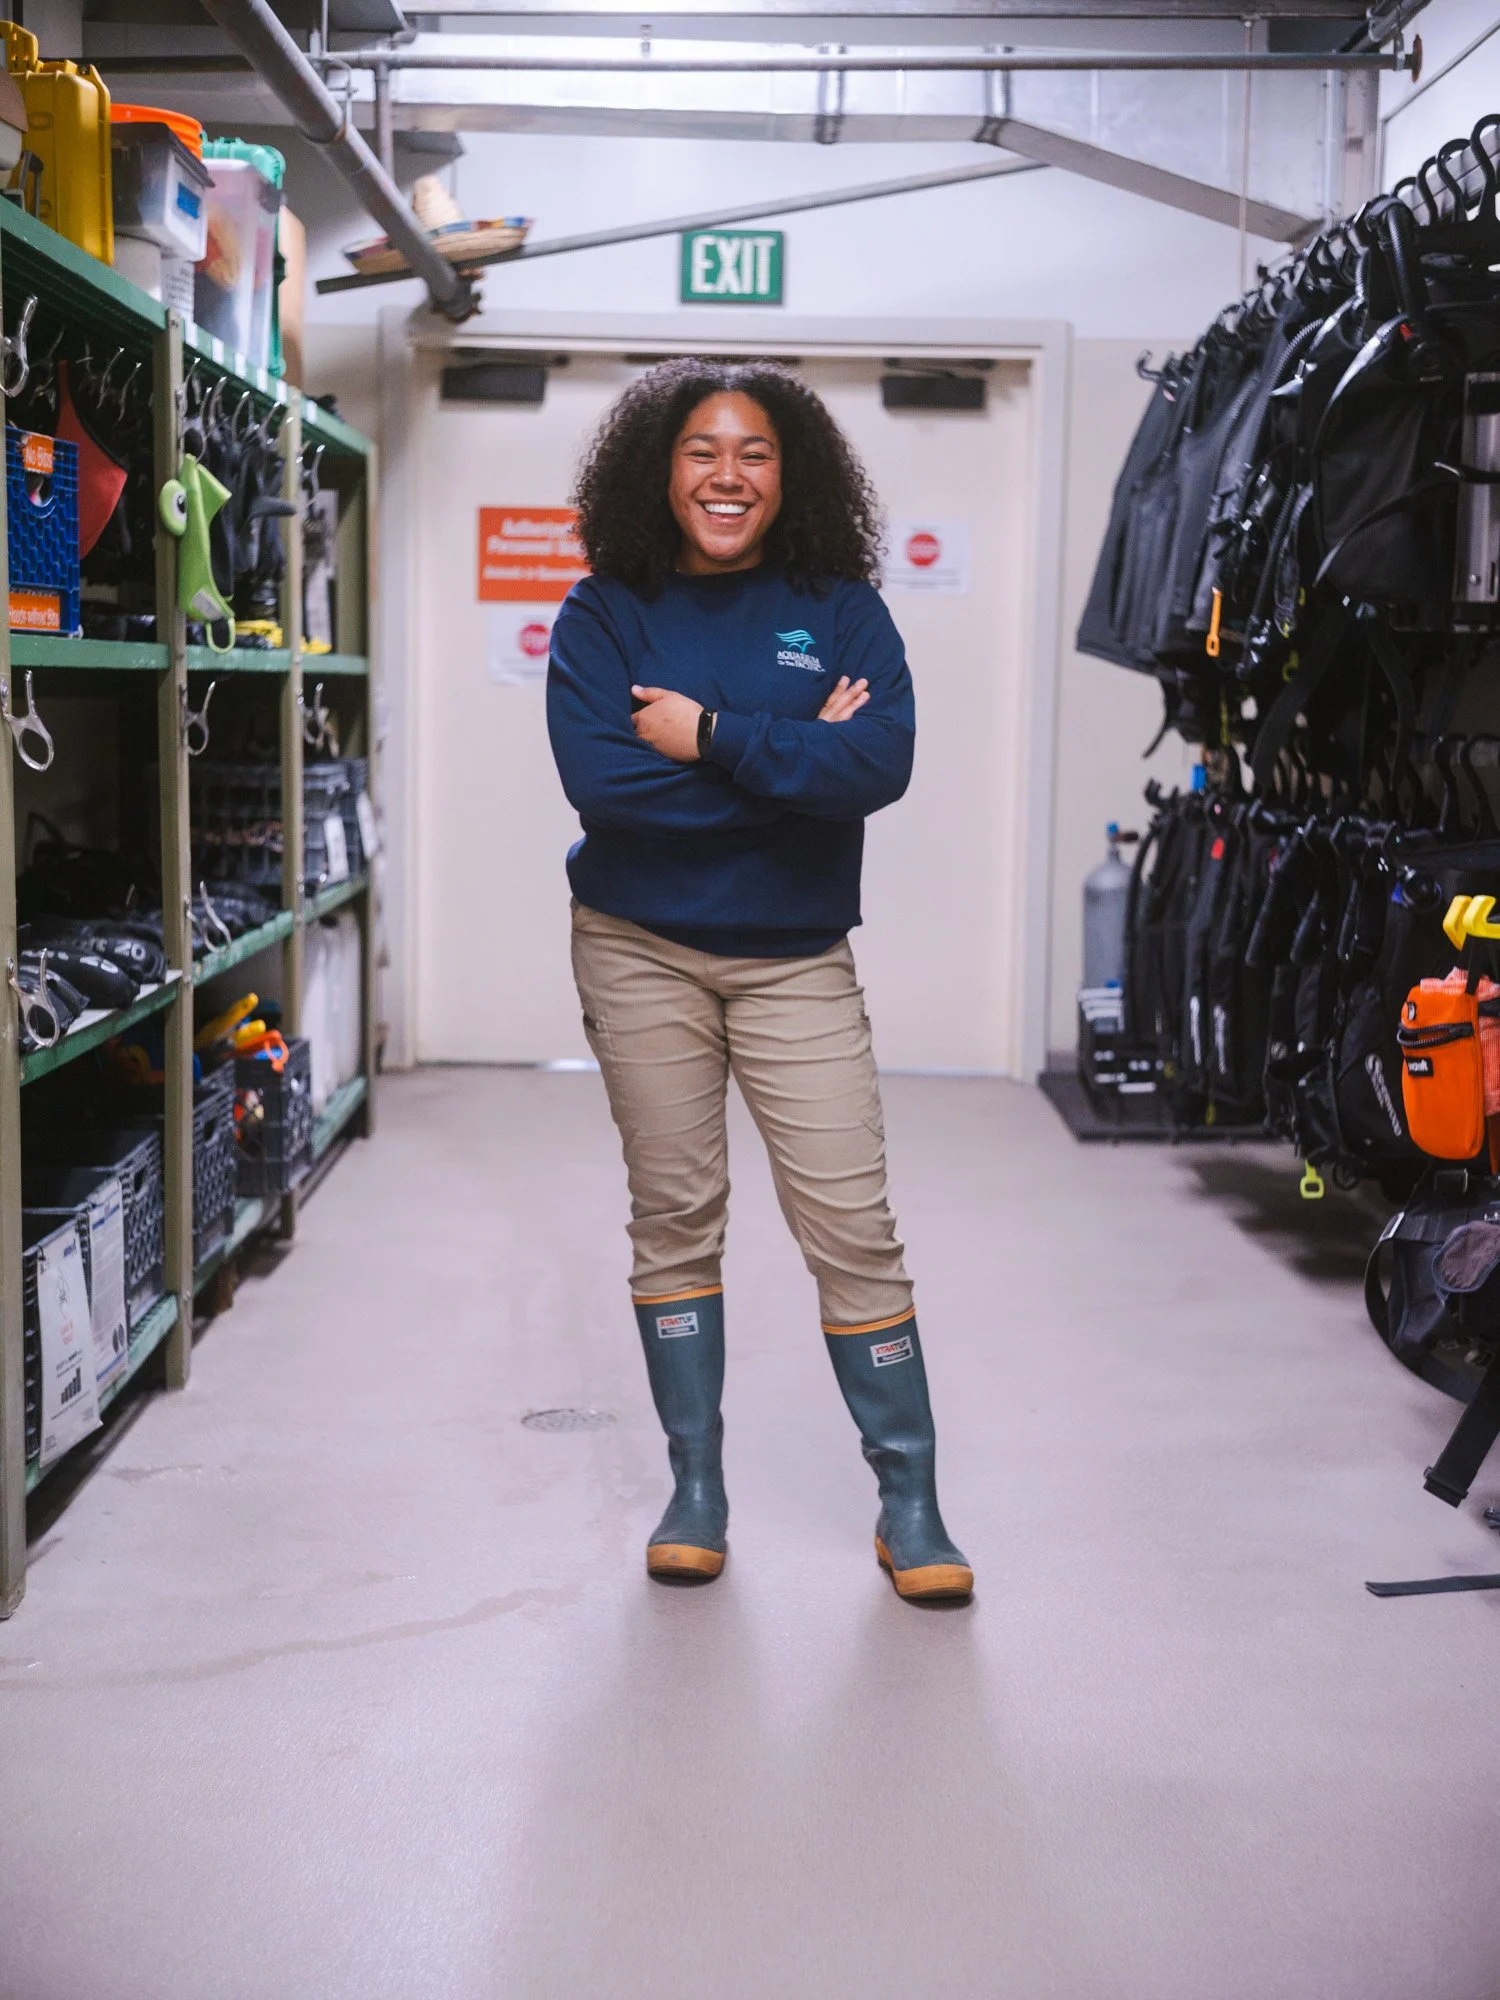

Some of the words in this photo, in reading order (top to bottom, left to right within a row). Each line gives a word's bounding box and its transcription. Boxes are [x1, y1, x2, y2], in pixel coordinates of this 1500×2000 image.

[691, 235, 776, 295] EXIT
[777, 650, 820, 667] AQUARIUM
[660, 1314, 693, 1328] XTRATUF
[875, 1338, 908, 1355] XTRATUF
